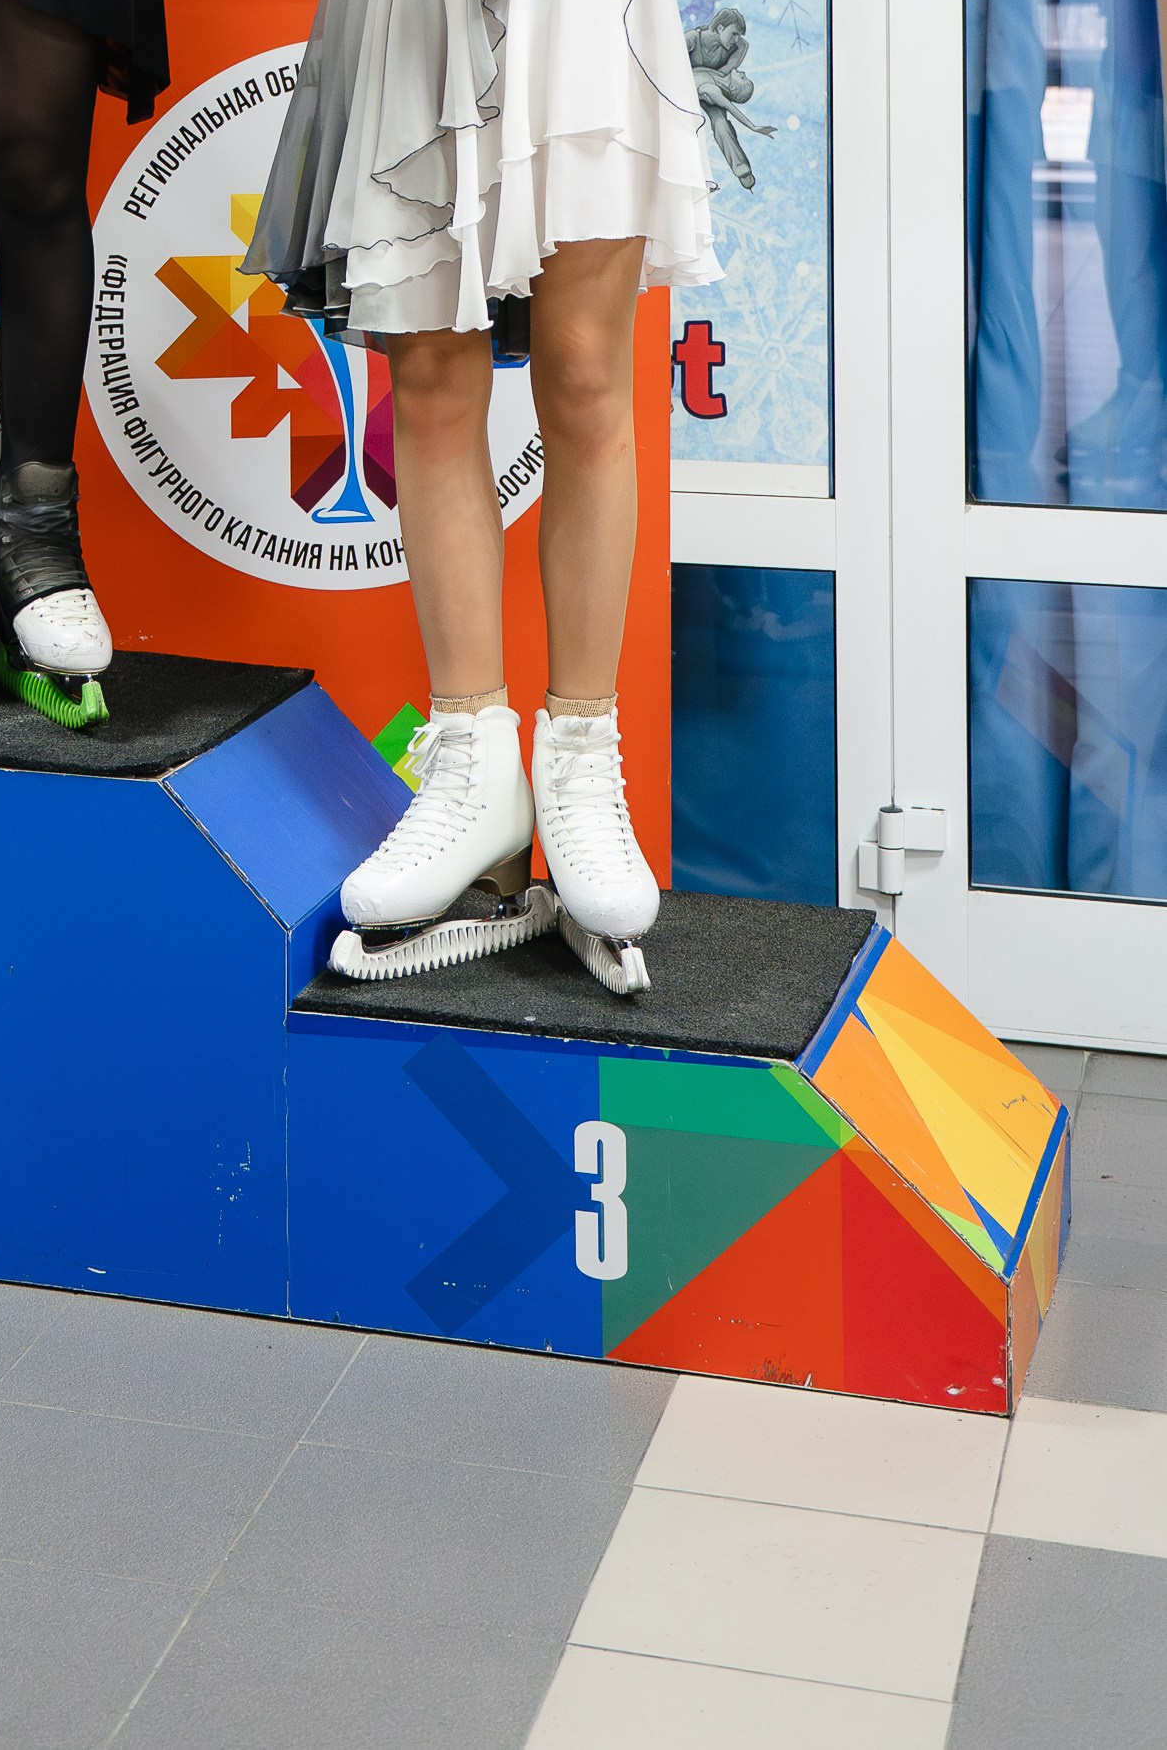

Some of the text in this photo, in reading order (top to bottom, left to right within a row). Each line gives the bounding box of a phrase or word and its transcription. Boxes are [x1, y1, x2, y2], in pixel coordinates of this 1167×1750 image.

[123, 78, 264, 221] РЕГИОНАЛЬНАЯ
[123, 416, 226, 532] ФИГУРНОГО
[220, 516, 323, 570] КАТАНИЯ
[329, 544, 359, 571] НА
[573, 1120, 628, 1281] 3
